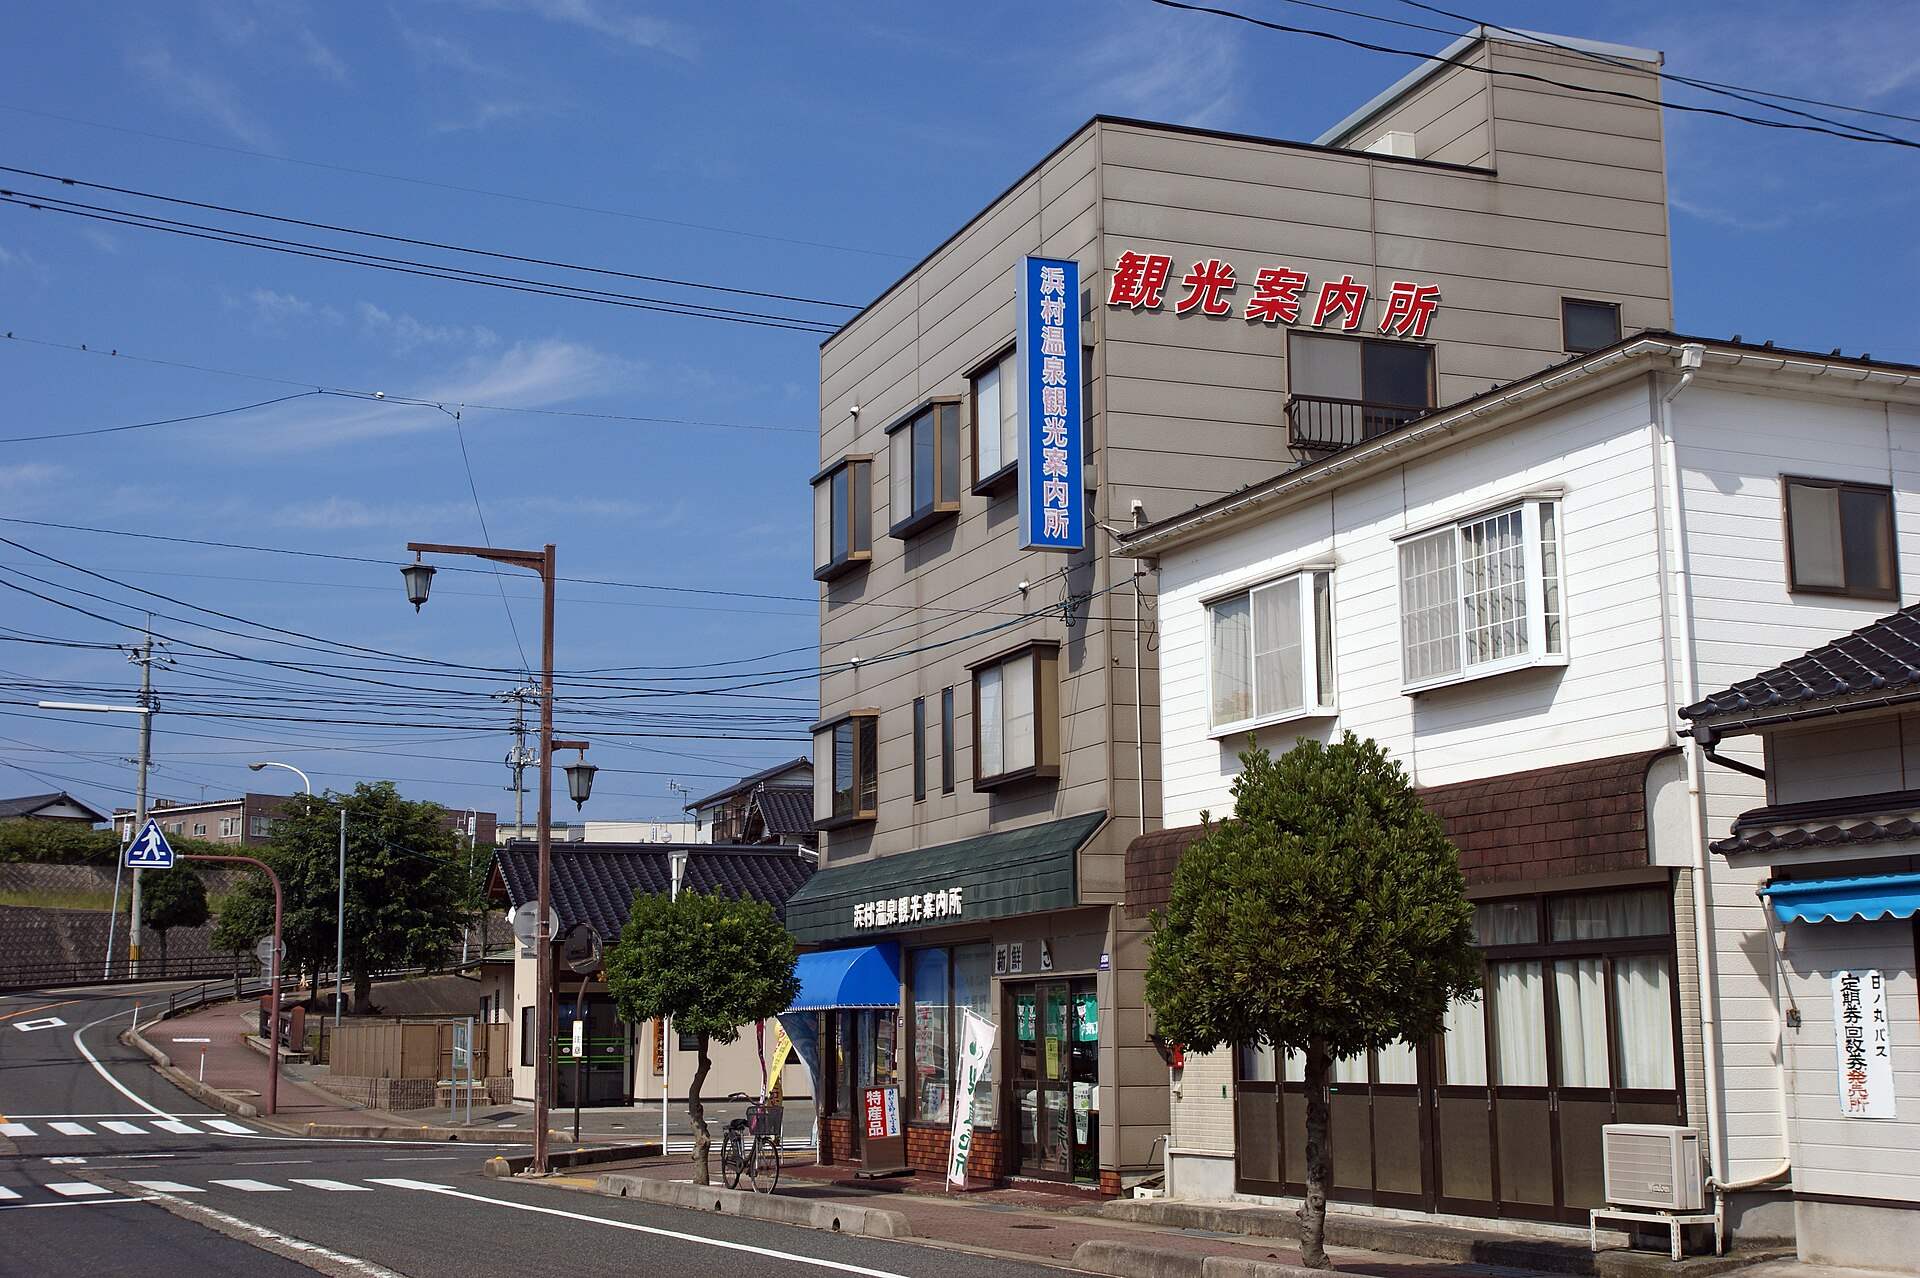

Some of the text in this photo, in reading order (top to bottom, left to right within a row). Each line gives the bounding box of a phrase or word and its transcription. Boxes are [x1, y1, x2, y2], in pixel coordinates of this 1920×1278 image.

[1107, 249, 1442, 338] 観光案内所
[1040, 265, 1070, 539] 浜村温泉観光案内所
[853, 887, 963, 928] 浜村温泉観光案内所
[1840, 972, 1870, 1114] 定期券回数券発売所
[1871, 975, 1888, 1058] 日ノ丸バス
[866, 1090, 884, 1137] 特産品
